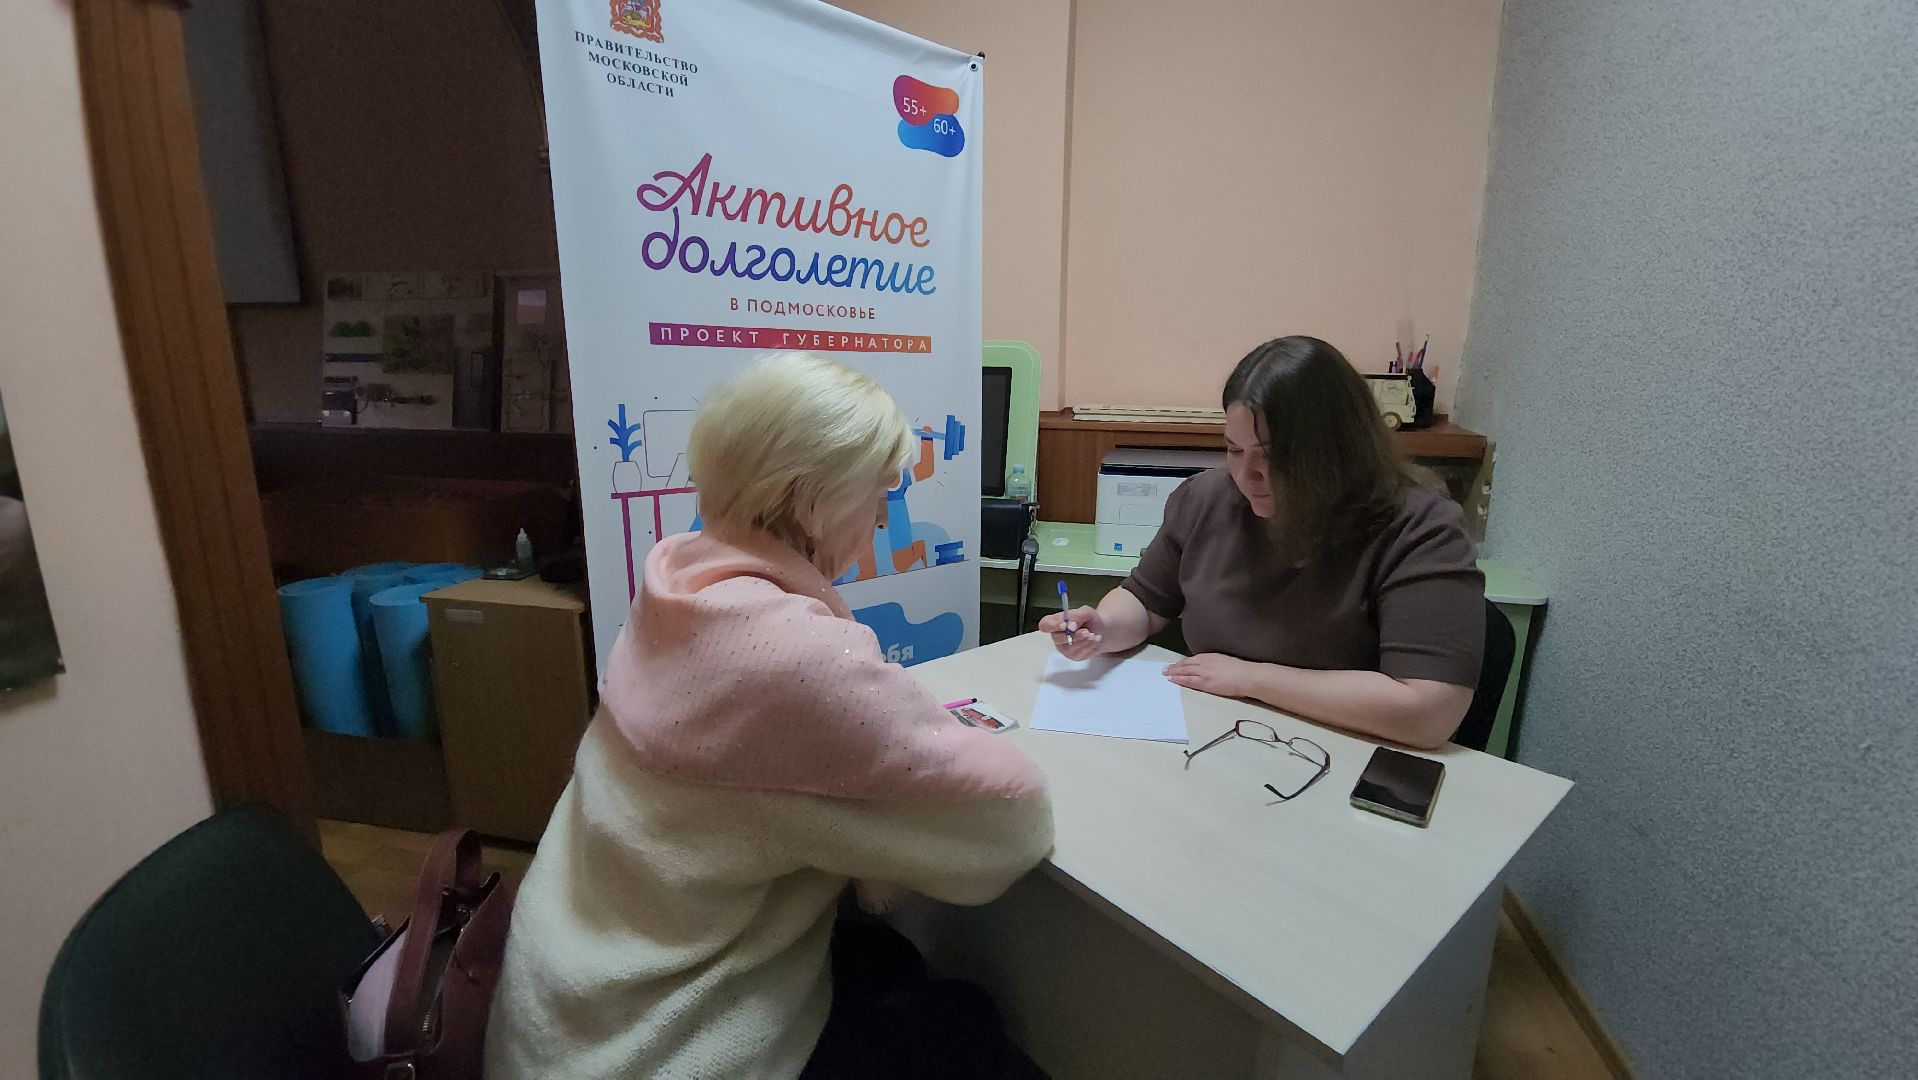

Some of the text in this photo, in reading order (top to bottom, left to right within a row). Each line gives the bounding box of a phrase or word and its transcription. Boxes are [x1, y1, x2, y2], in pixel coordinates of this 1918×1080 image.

[575, 31, 698, 74] ПРАВИТЕЛЬСТВО
[588, 51, 688, 86] МОСКОВСКОЙ
[607, 72, 674, 97] ОБЛАСТИ
[903, 96, 927, 117] 55+
[933, 118, 956, 136] 60+
[636, 153, 930, 248] Активное
[641, 206, 937, 296] долголетие
[730, 297, 876, 320] В ПОДМОСКОВЬЕ
[660, 327, 927, 351] ПРОЕКТ ГУБЕРНАТОРА
